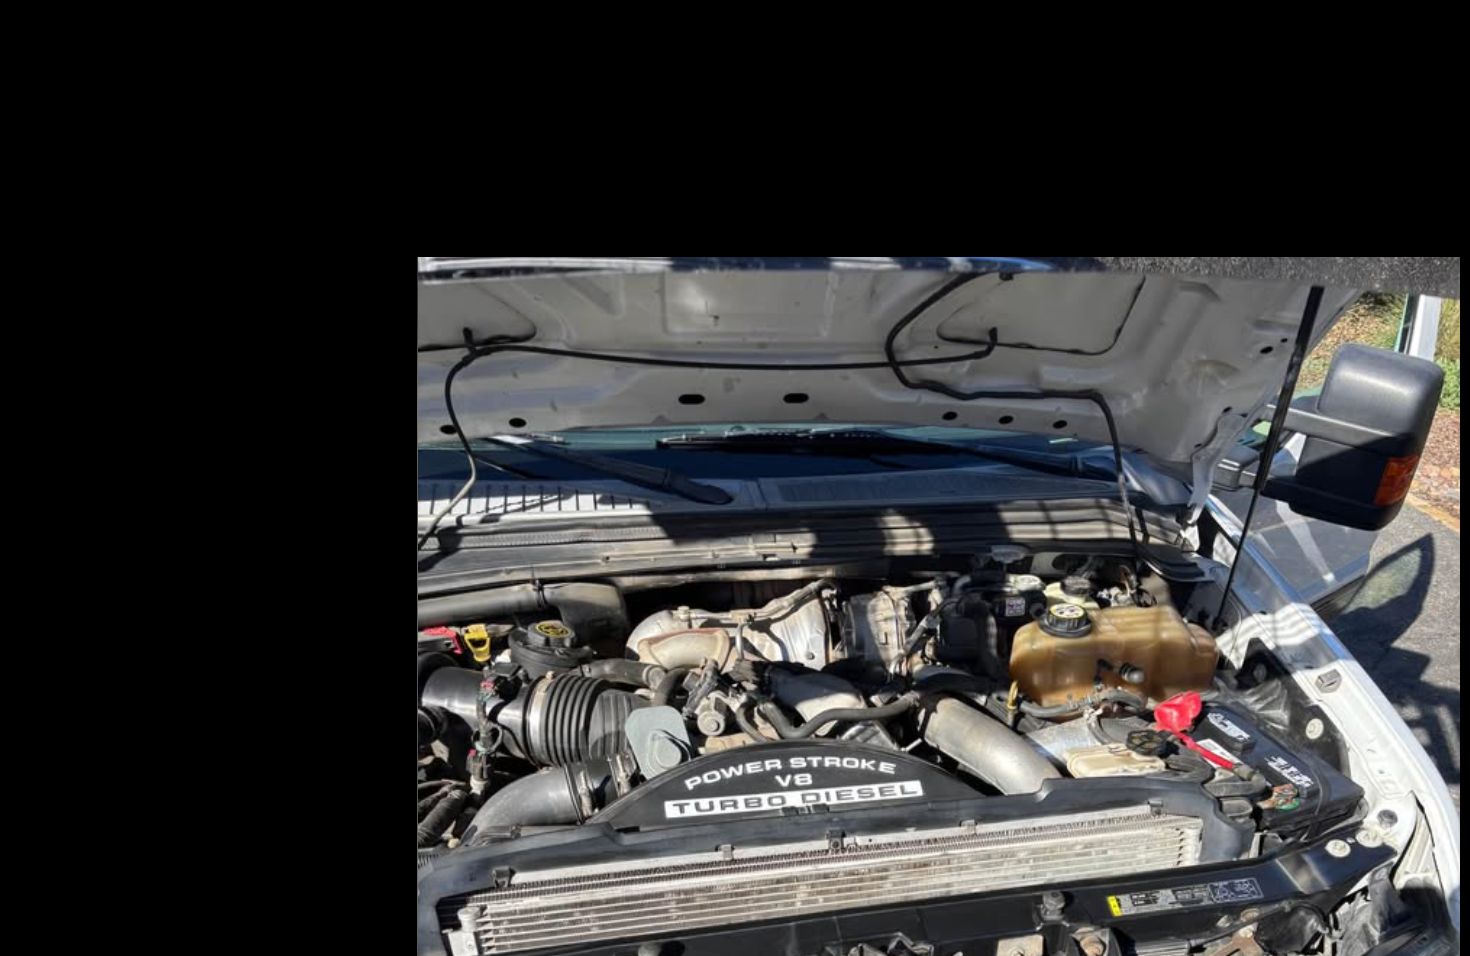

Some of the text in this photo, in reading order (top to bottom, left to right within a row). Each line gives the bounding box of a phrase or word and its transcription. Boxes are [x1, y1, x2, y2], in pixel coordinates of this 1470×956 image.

[684, 756, 897, 790] POWER STROKE
[775, 773, 813, 788] V8
[673, 784, 919, 815] TURBO DIESEL
